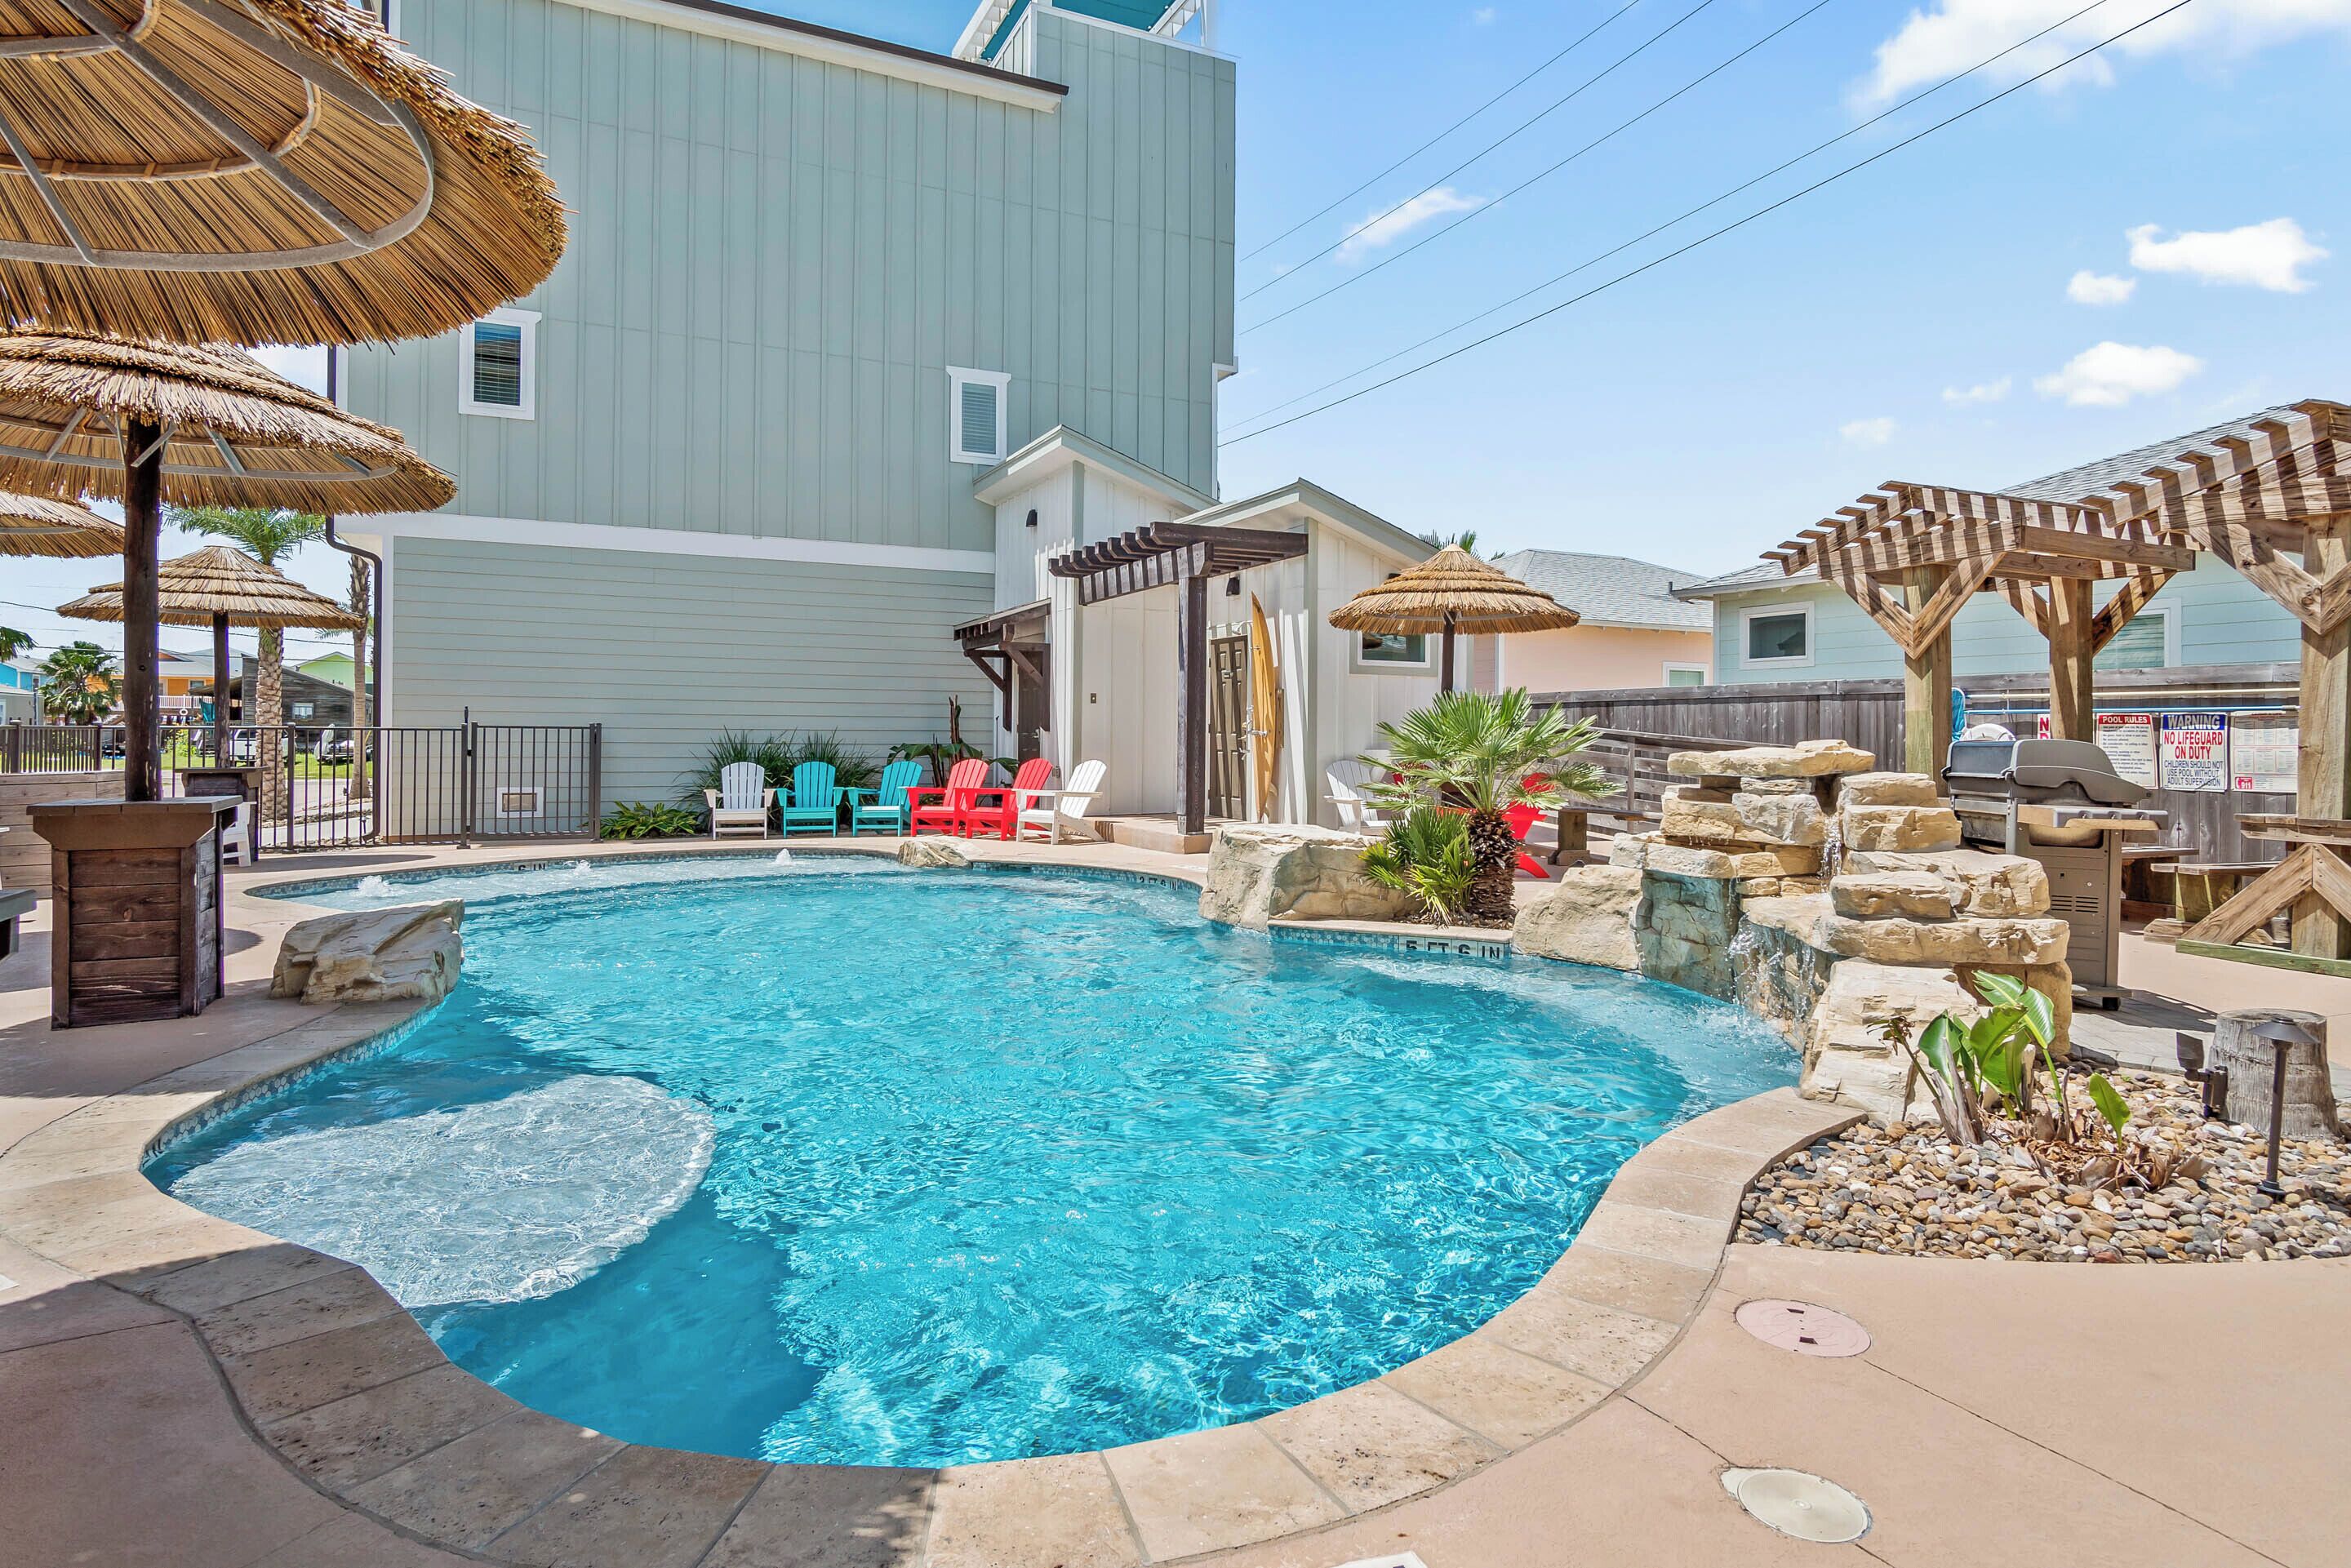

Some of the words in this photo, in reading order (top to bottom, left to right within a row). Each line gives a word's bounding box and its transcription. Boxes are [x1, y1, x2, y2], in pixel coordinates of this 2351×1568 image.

[2167, 714, 2220, 730] WARNING
[2164, 731, 2175, 745] NO
[2177, 731, 2223, 745] LIFEGUARD
[2175, 746, 2186, 759] ON
[2189, 746, 2211, 759] DUTY
[2164, 760, 2189, 768] CHILDREN
[2190, 760, 2212, 768] SHOULD
[2212, 761, 2224, 769] NOT
[2167, 768, 2178, 776] USE
[2179, 769, 2193, 777] POOL
[2194, 769, 2219, 778] WITHOUT
[2167, 776, 2184, 785] ADULT
[2184, 777, 2220, 787] SUPERVISION
[1406, 939, 1418, 950] 5
[1427, 941, 1449, 953] FT
[1458, 944, 1470, 955] 6
[1482, 945, 1500, 959] IN
